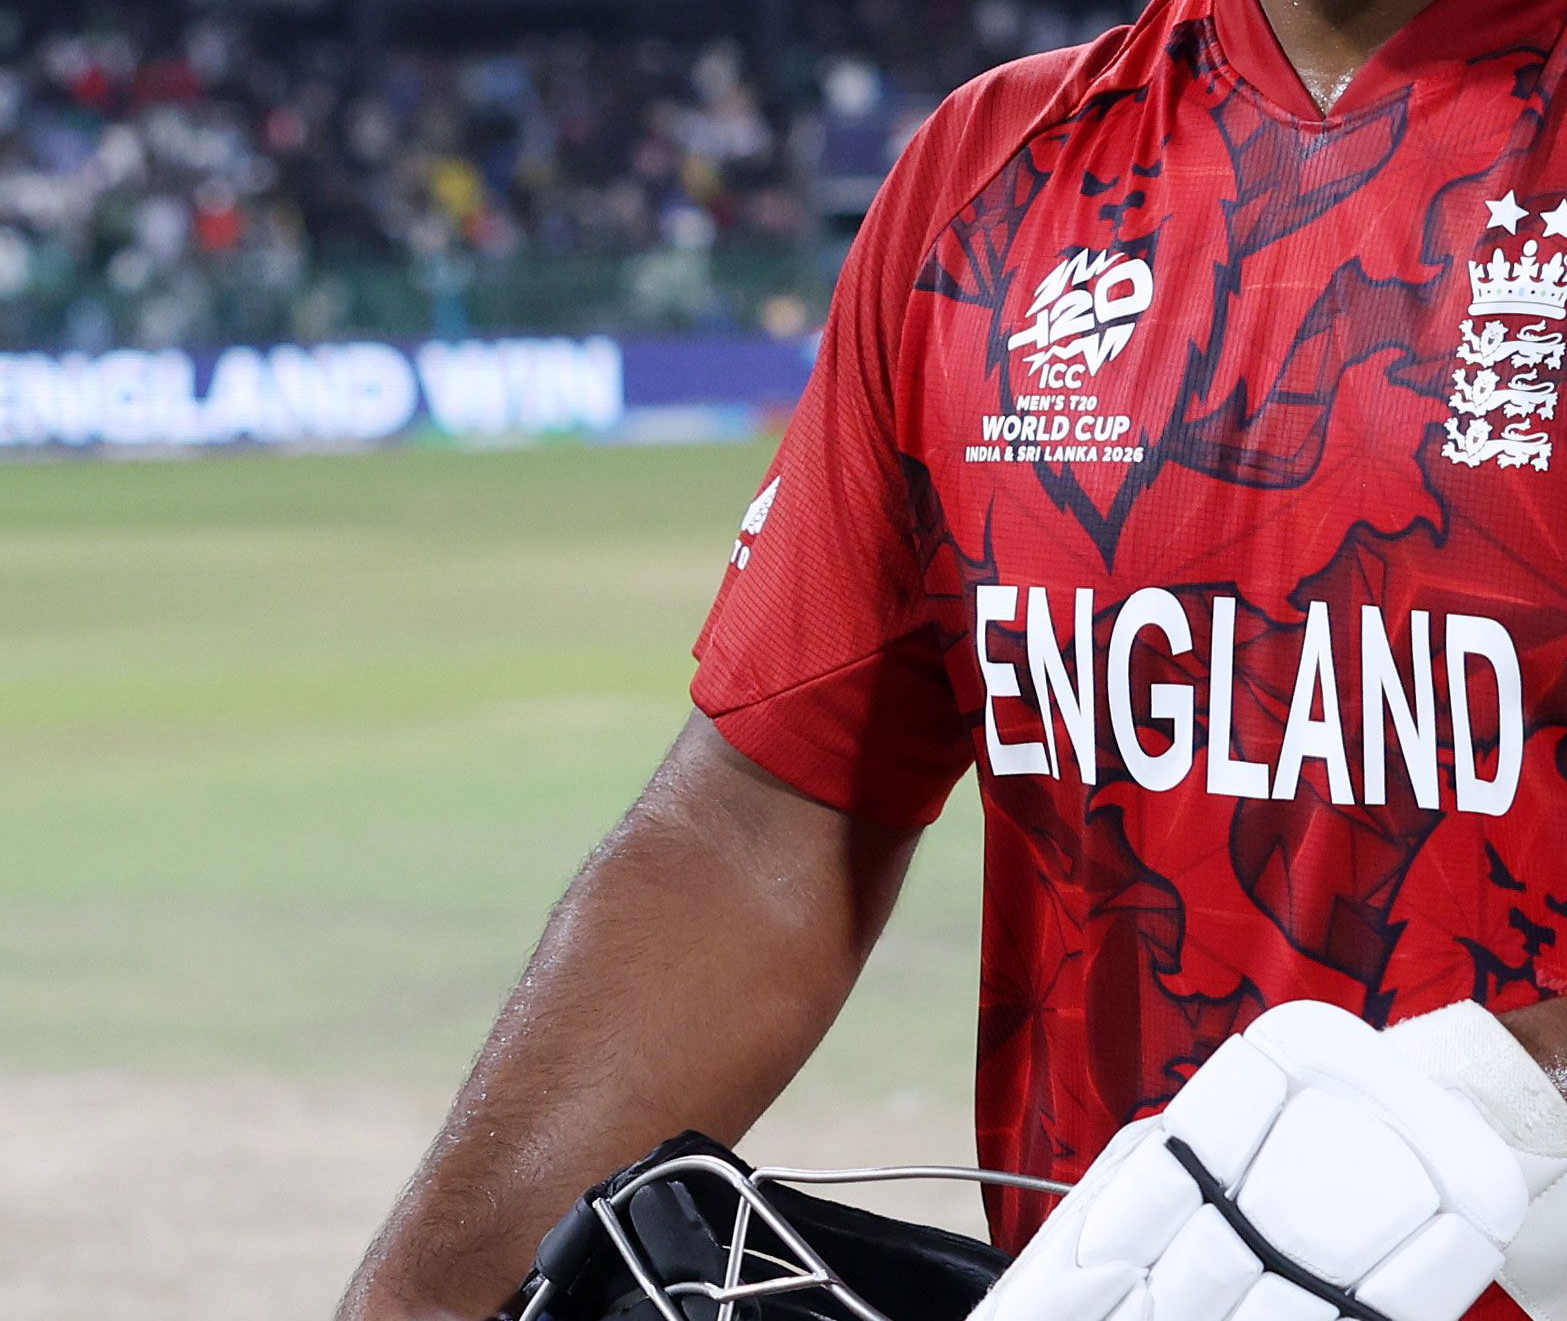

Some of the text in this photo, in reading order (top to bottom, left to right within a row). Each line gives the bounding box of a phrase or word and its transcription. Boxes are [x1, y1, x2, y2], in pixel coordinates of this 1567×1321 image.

[415, 335, 625, 435] WIN
[1039, 363, 1086, 389] ICC
[1016, 395, 1098, 411] MEN'S T20
[982, 415, 1131, 441] WORLD CUP
[965, 446, 1144, 463] INDIA & SRI LANKA 2026
[975, 584, 1524, 817] ENGLAND
